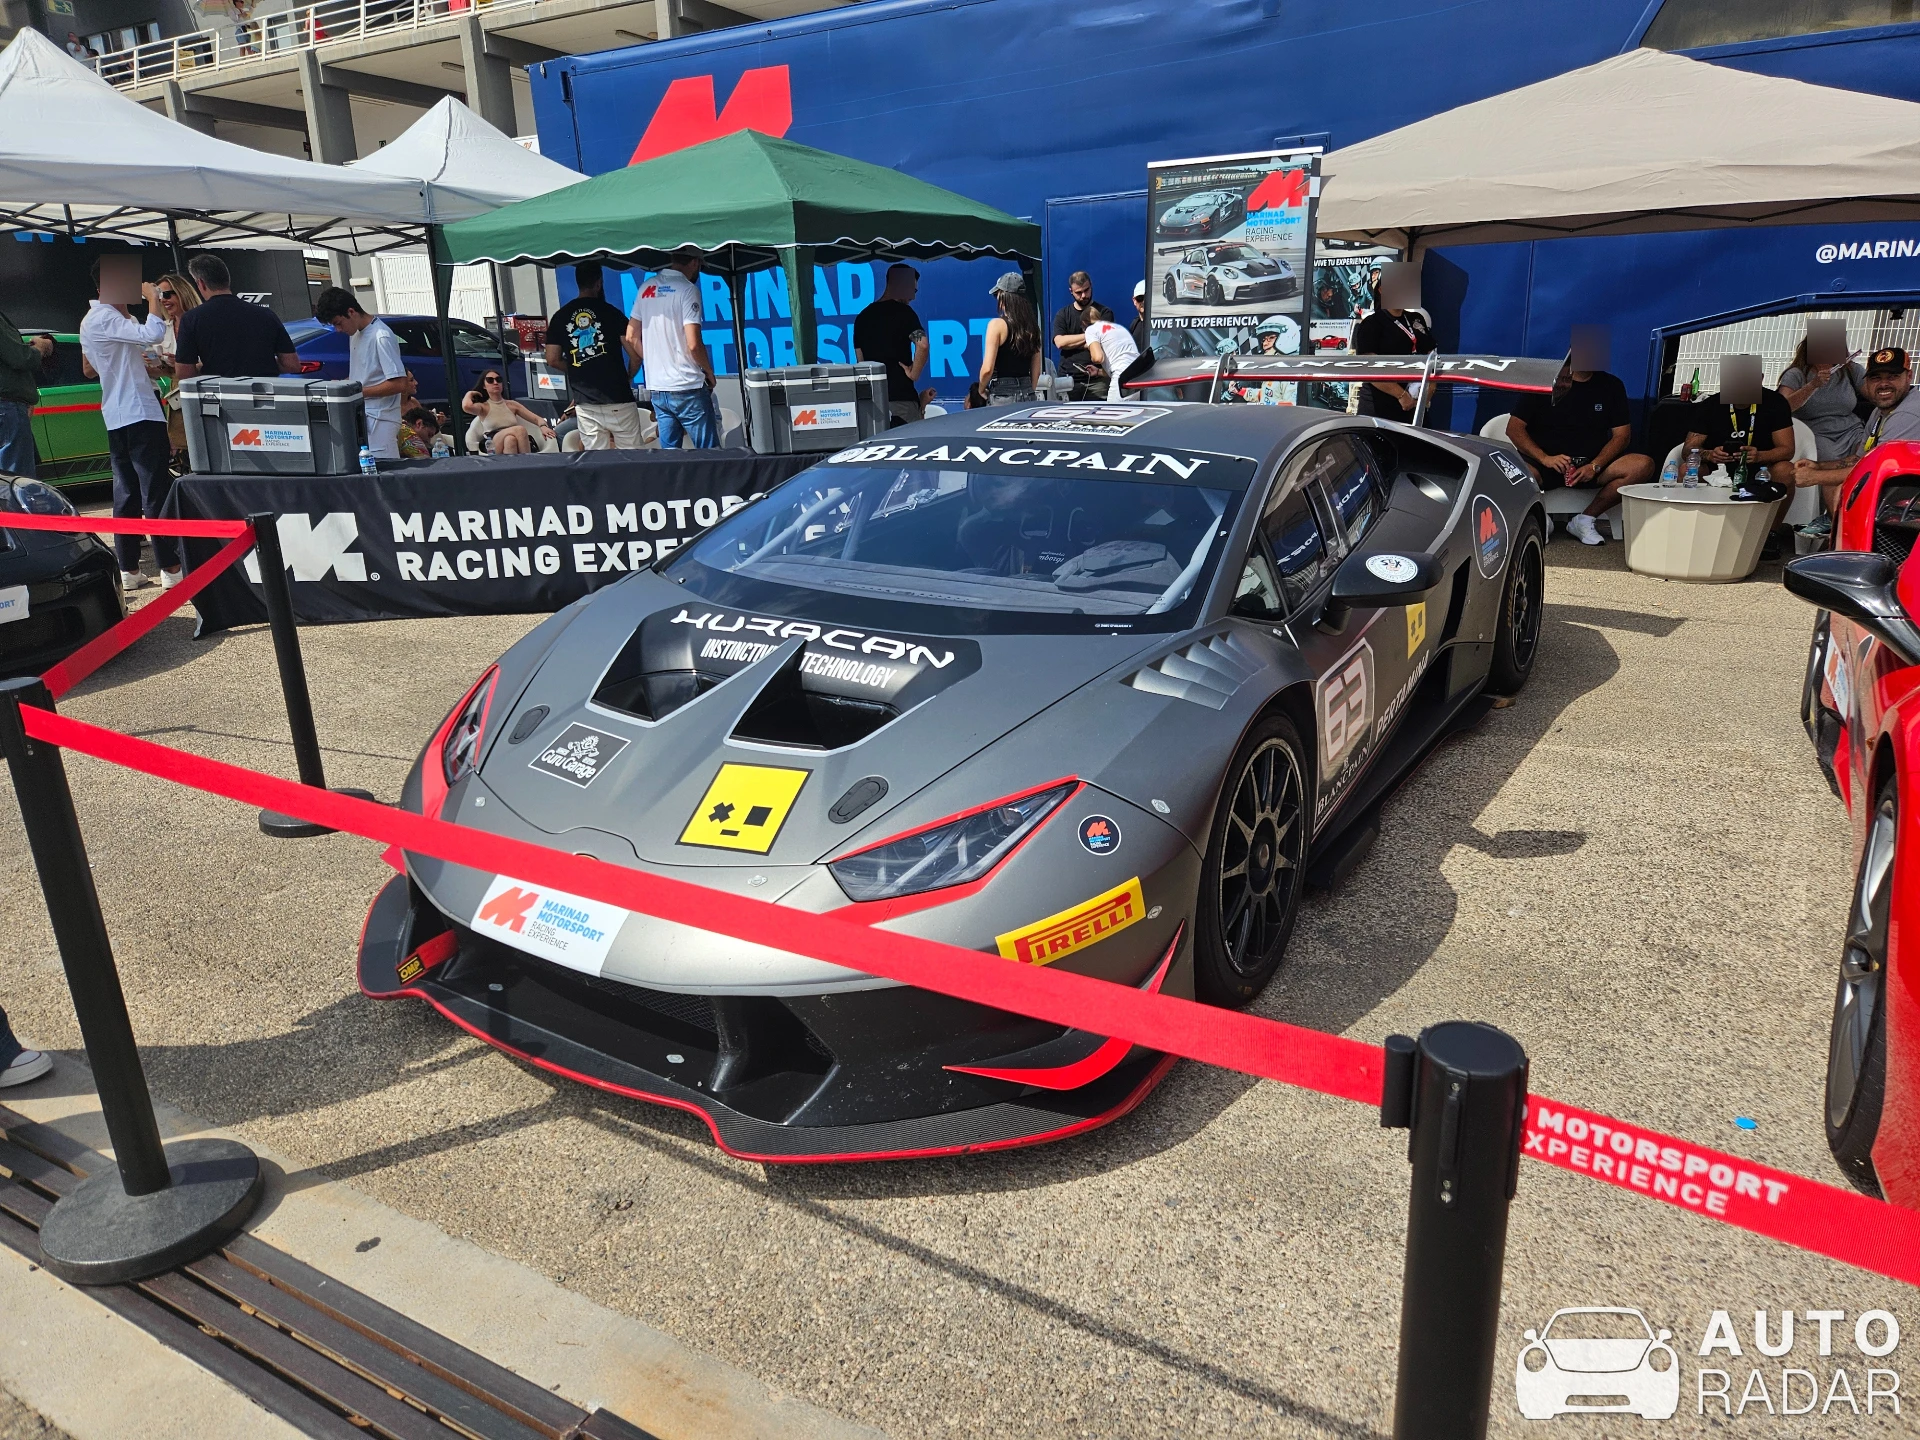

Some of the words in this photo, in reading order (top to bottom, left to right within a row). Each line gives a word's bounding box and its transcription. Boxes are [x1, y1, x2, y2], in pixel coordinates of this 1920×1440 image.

[1246, 210, 1285, 220] MARINAD
[1246, 217, 1302, 227] MOTORSPORT
[1245, 226, 1274, 236] RACING
[1245, 233, 1293, 243] EXPERIENCE
[1150, 318, 1173, 329] VIVE
[1175, 317, 1189, 328] TU
[1191, 316, 1259, 328] EXPERIENCIA
[846, 444, 1210, 480] BLANCPAIN
[390, 504, 593, 543] MARINAD
[396, 544, 561, 582] RACING
[798, 651, 899, 690] TECHNOLOGY
[1324, 656, 1368, 763] 63
[541, 749, 567, 767] Guru
[561, 757, 597, 779] Garage
[536, 910, 605, 943] MOTORSPORT
[542, 899, 590, 925] MARINAD
[527, 930, 569, 951] EXPERIENCE
[530, 921, 557, 937] RACING
[1013, 891, 1134, 964] PIRELLI
[1537, 1106, 1789, 1206] MOTORSPORT
